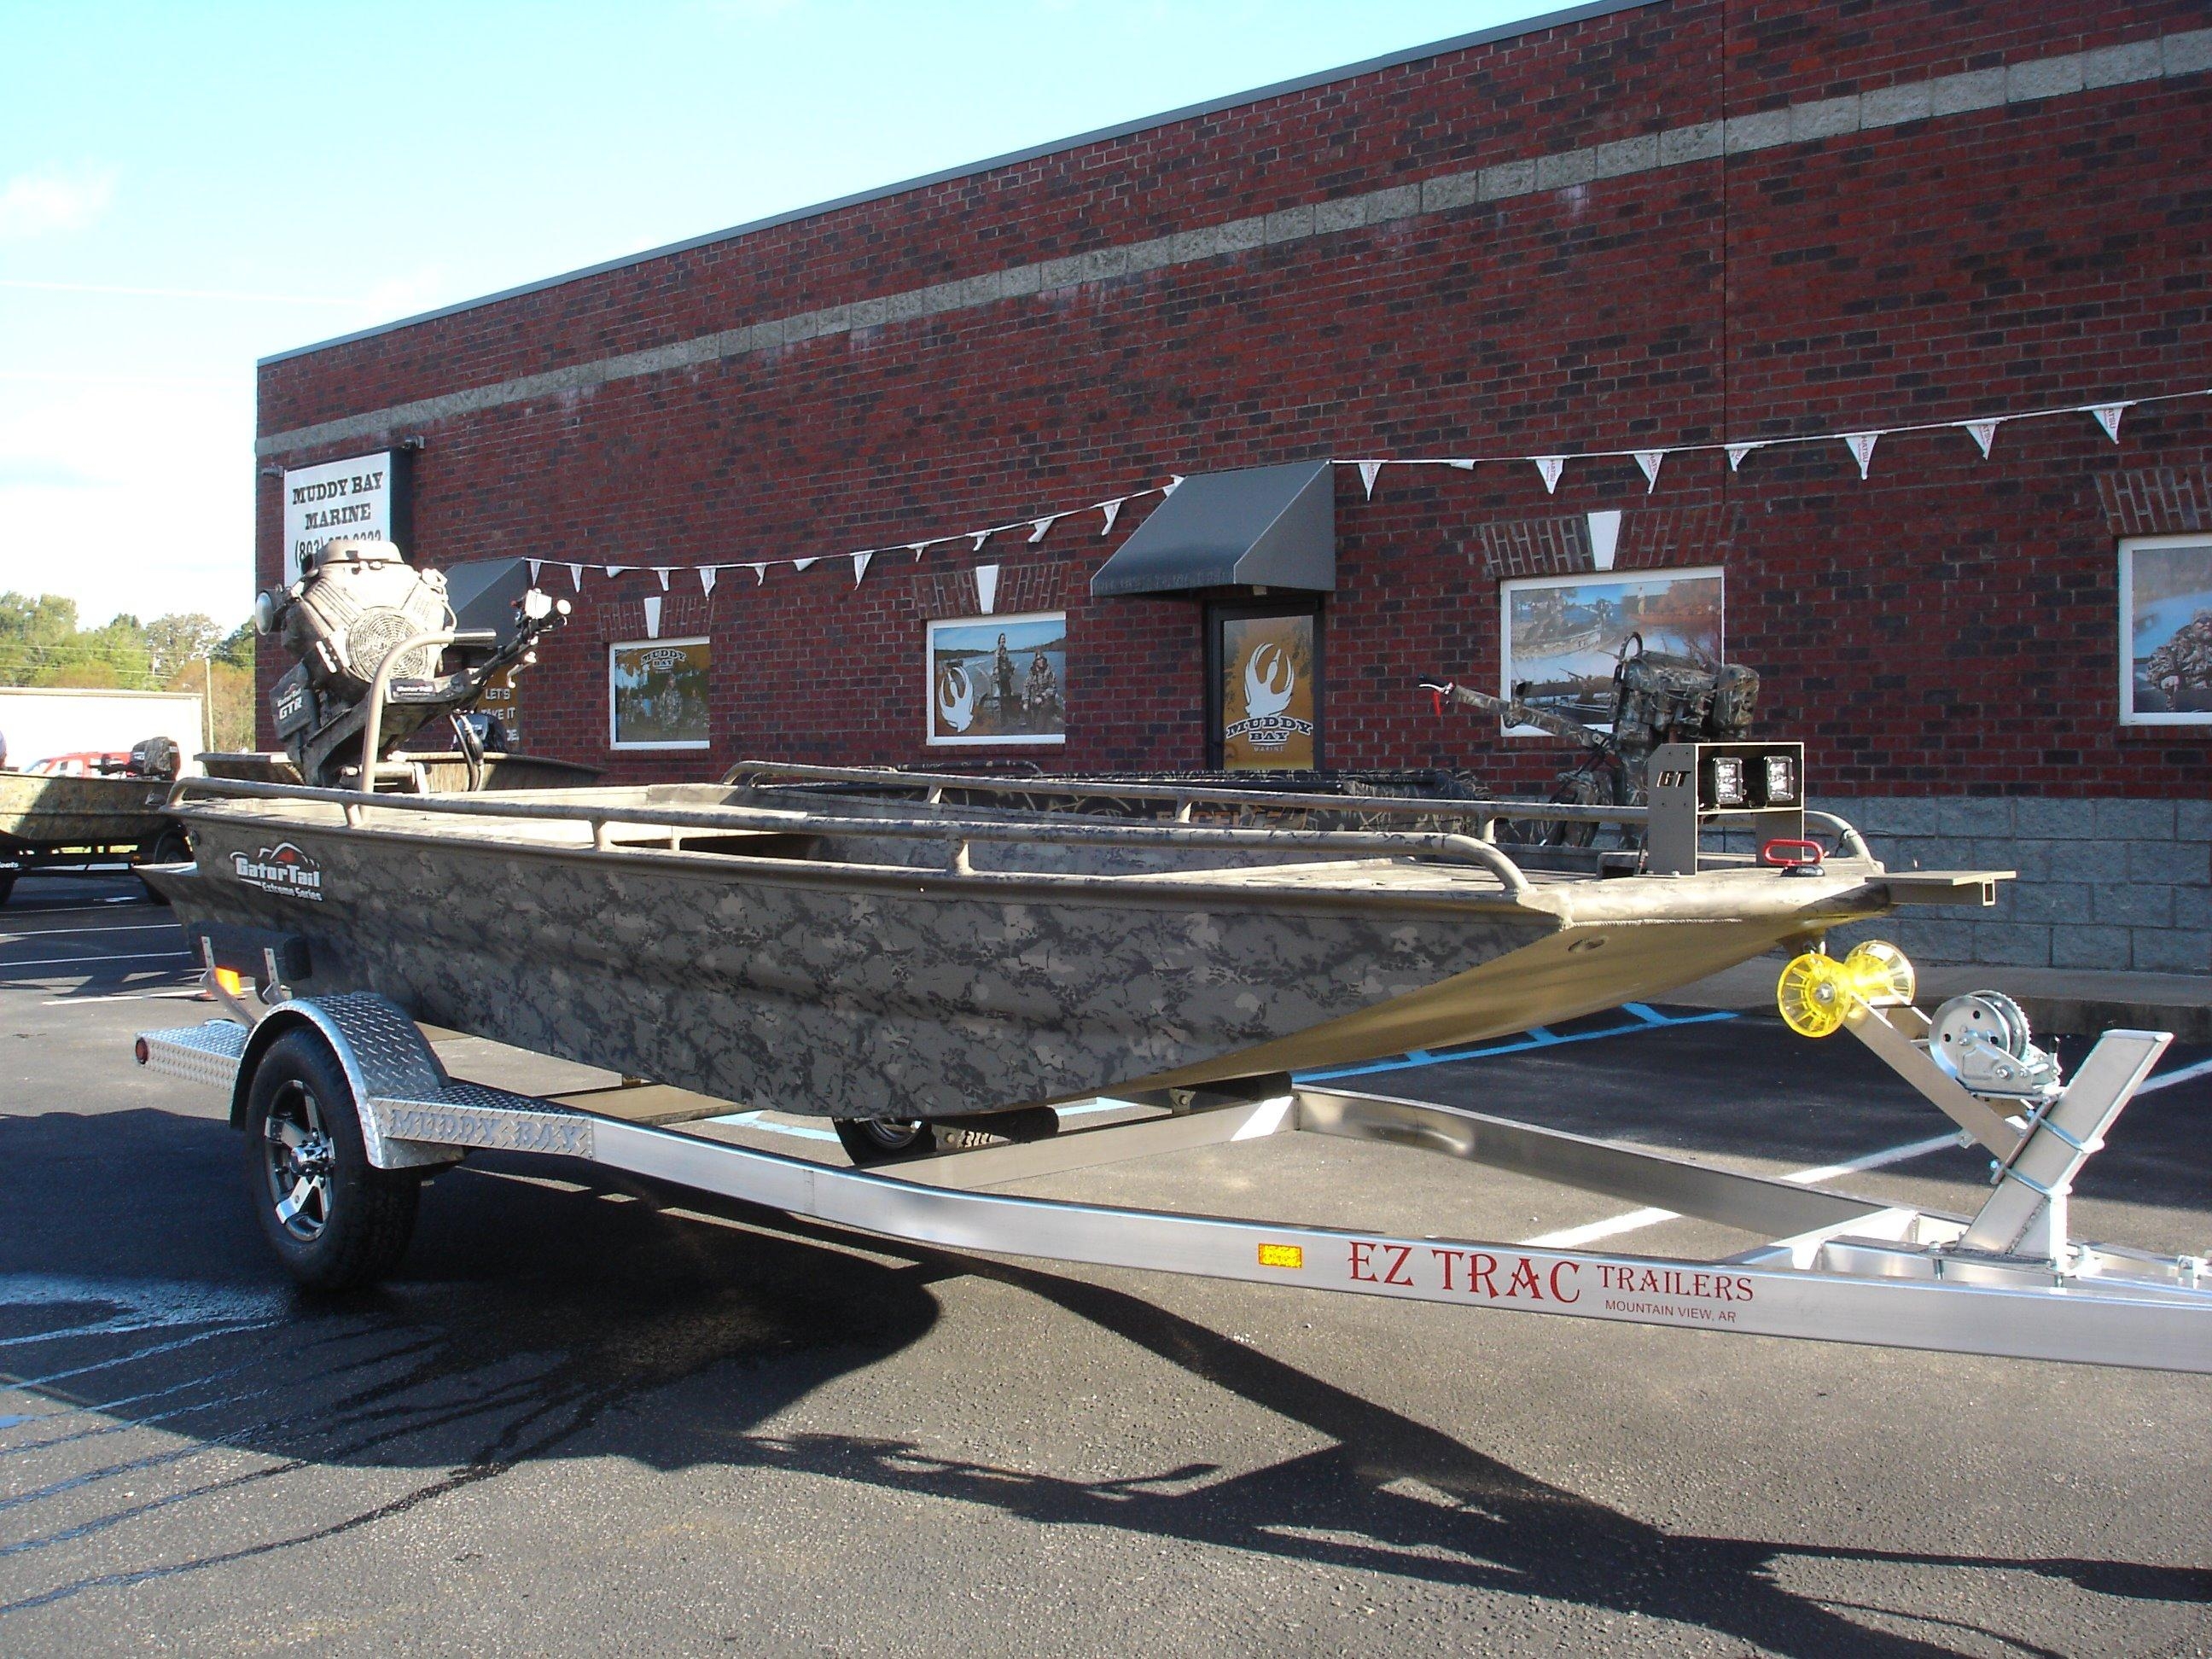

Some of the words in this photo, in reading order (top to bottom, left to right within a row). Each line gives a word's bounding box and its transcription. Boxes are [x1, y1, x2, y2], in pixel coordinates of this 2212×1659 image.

[293, 478, 348, 505] MUDDY
[352, 471, 383, 494] BAY
[305, 503, 371, 531] MARINE
[641, 649, 687, 666] MUDDY
[653, 659, 673, 667] BAY
[485, 688, 511, 700] LET'S
[279, 696, 303, 720] GTR
[507, 707, 516, 719] IT
[1226, 716, 1313, 738] MUDDY
[1249, 731, 1289, 742] BAY
[1656, 771, 1691, 787] GT
[236, 856, 320, 888] GatorTail
[390, 1109, 502, 1144] MUDDY
[514, 1120, 584, 1150] BAY
[1348, 1241, 1414, 1287] EZ
[1431, 1249, 1580, 1303] TRAC
[1597, 1265, 1754, 1301] TRAILERS
[1605, 1300, 1674, 1317] MOUNTAIN
[1718, 1310, 1738, 1324] AR
